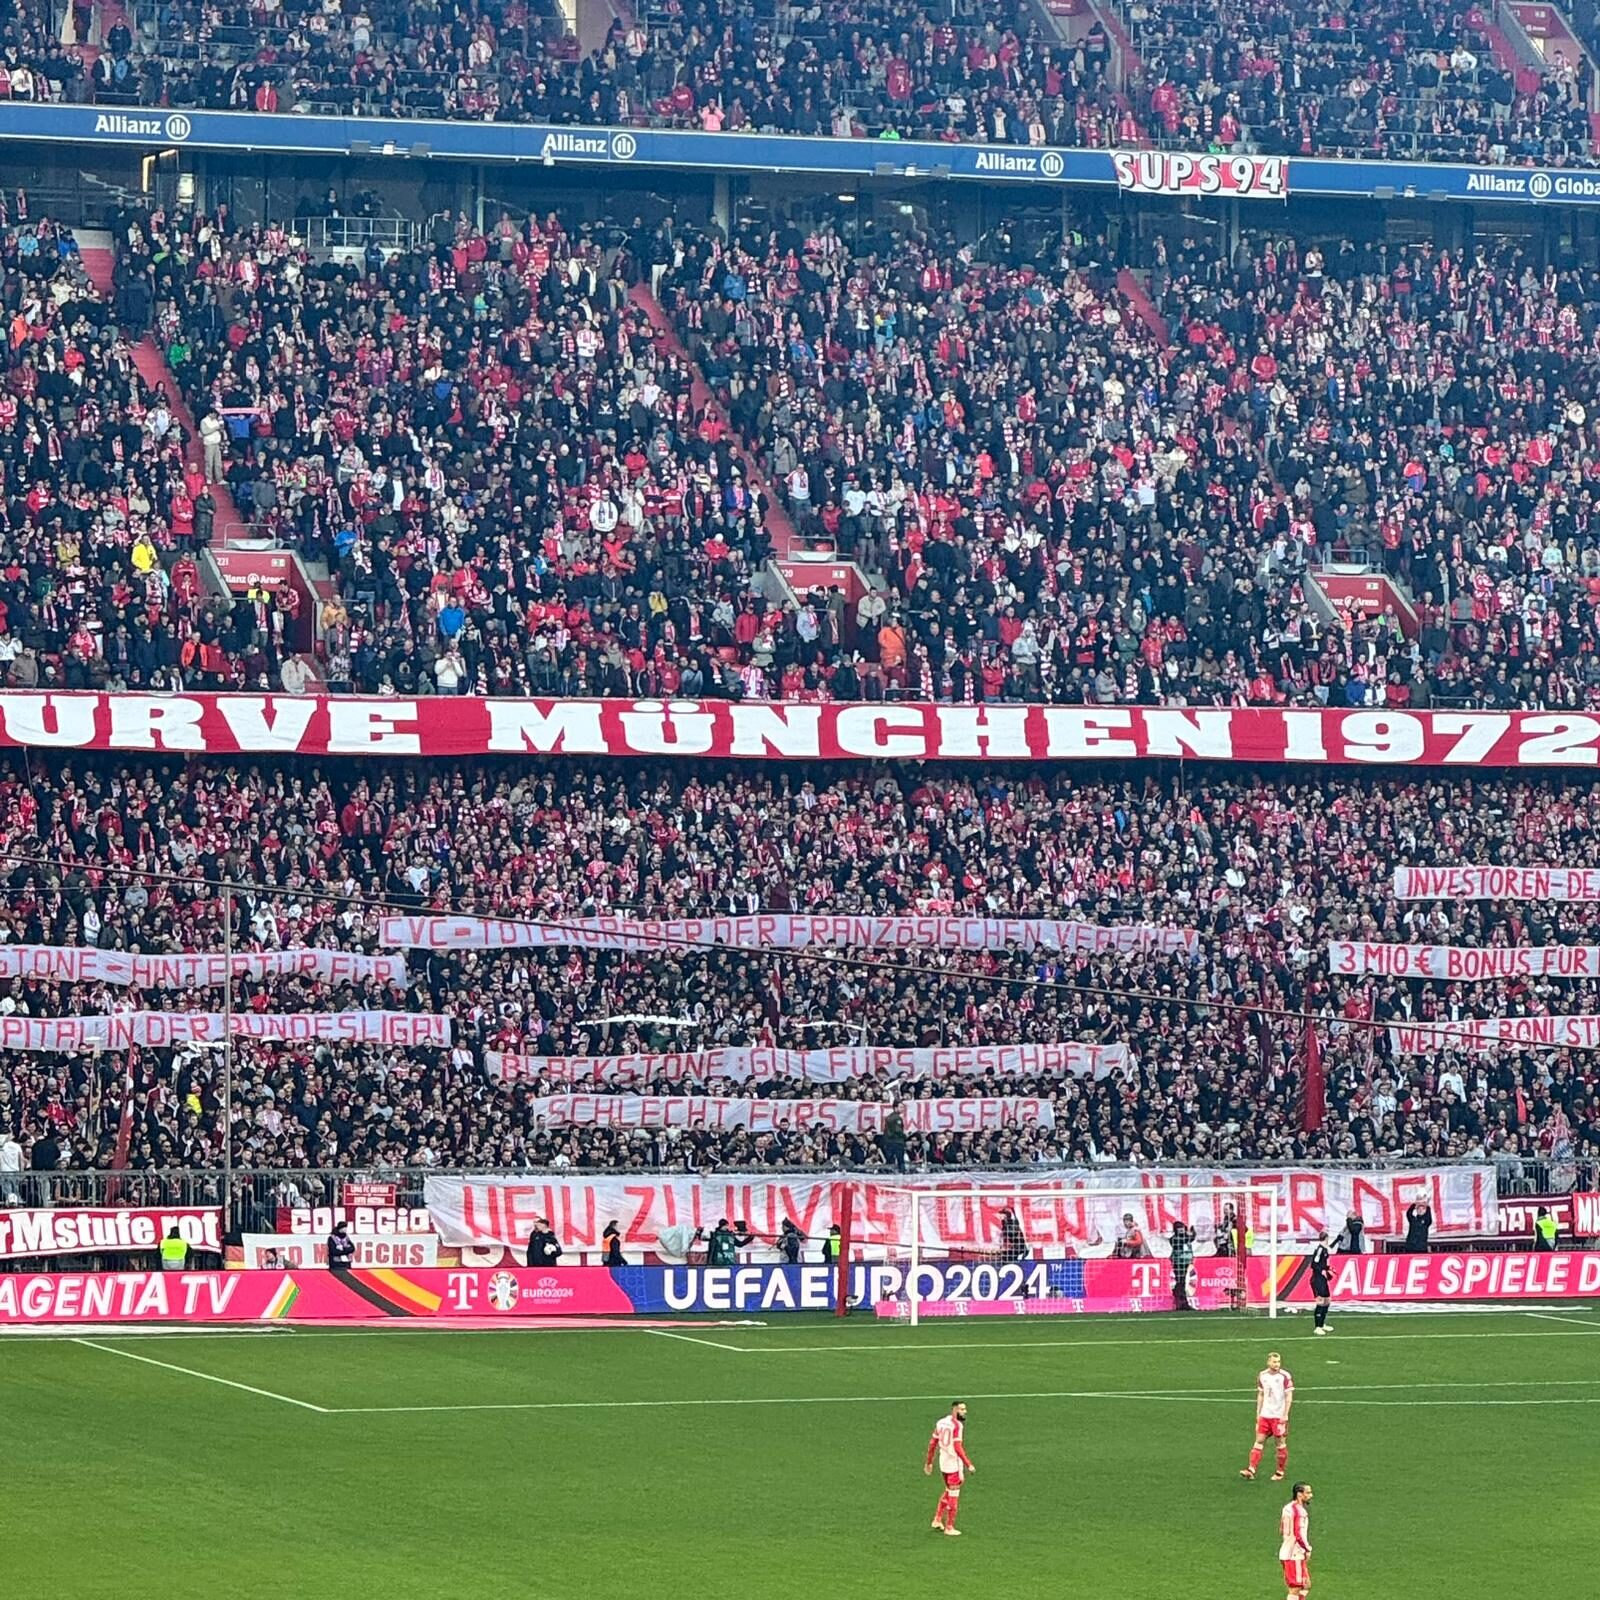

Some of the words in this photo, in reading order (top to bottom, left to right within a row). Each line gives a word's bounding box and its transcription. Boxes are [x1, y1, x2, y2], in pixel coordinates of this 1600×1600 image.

[95, 114, 161, 135] Allianz
[543, 133, 607, 153] Allianz
[975, 152, 1036, 171] Allianz
[1114, 152, 1221, 193] SUPS
[1231, 157, 1283, 194] 94
[1467, 173, 1525, 192] Allianz
[0, 694, 421, 754] URVE
[487, 699, 1234, 759] MÜNCHEN
[1283, 711, 1600, 764] 1972
[1407, 867, 1600, 898] INVESTOREN-DE
[1338, 943, 1356, 974] 3
[1364, 943, 1408, 975] MIO
[1414, 952, 1433, 977] €
[1449, 949, 1531, 978] BONUS
[1543, 945, 1588, 975] FÜR
[108, 1016, 135, 1048] IN
[1566, 1014, 1600, 1049] ST
[829, 1049, 915, 1079] FÜRS
[548, 1097, 730, 1128] SCHLECHT
[750, 1101, 837, 1131] FÜRS
[1332, 1254, 1430, 1296] ALLE
[1438, 1253, 1570, 1295] SPIELE
[0, 1272, 169, 1318] AGENTA
[181, 1273, 241, 1314] TV
